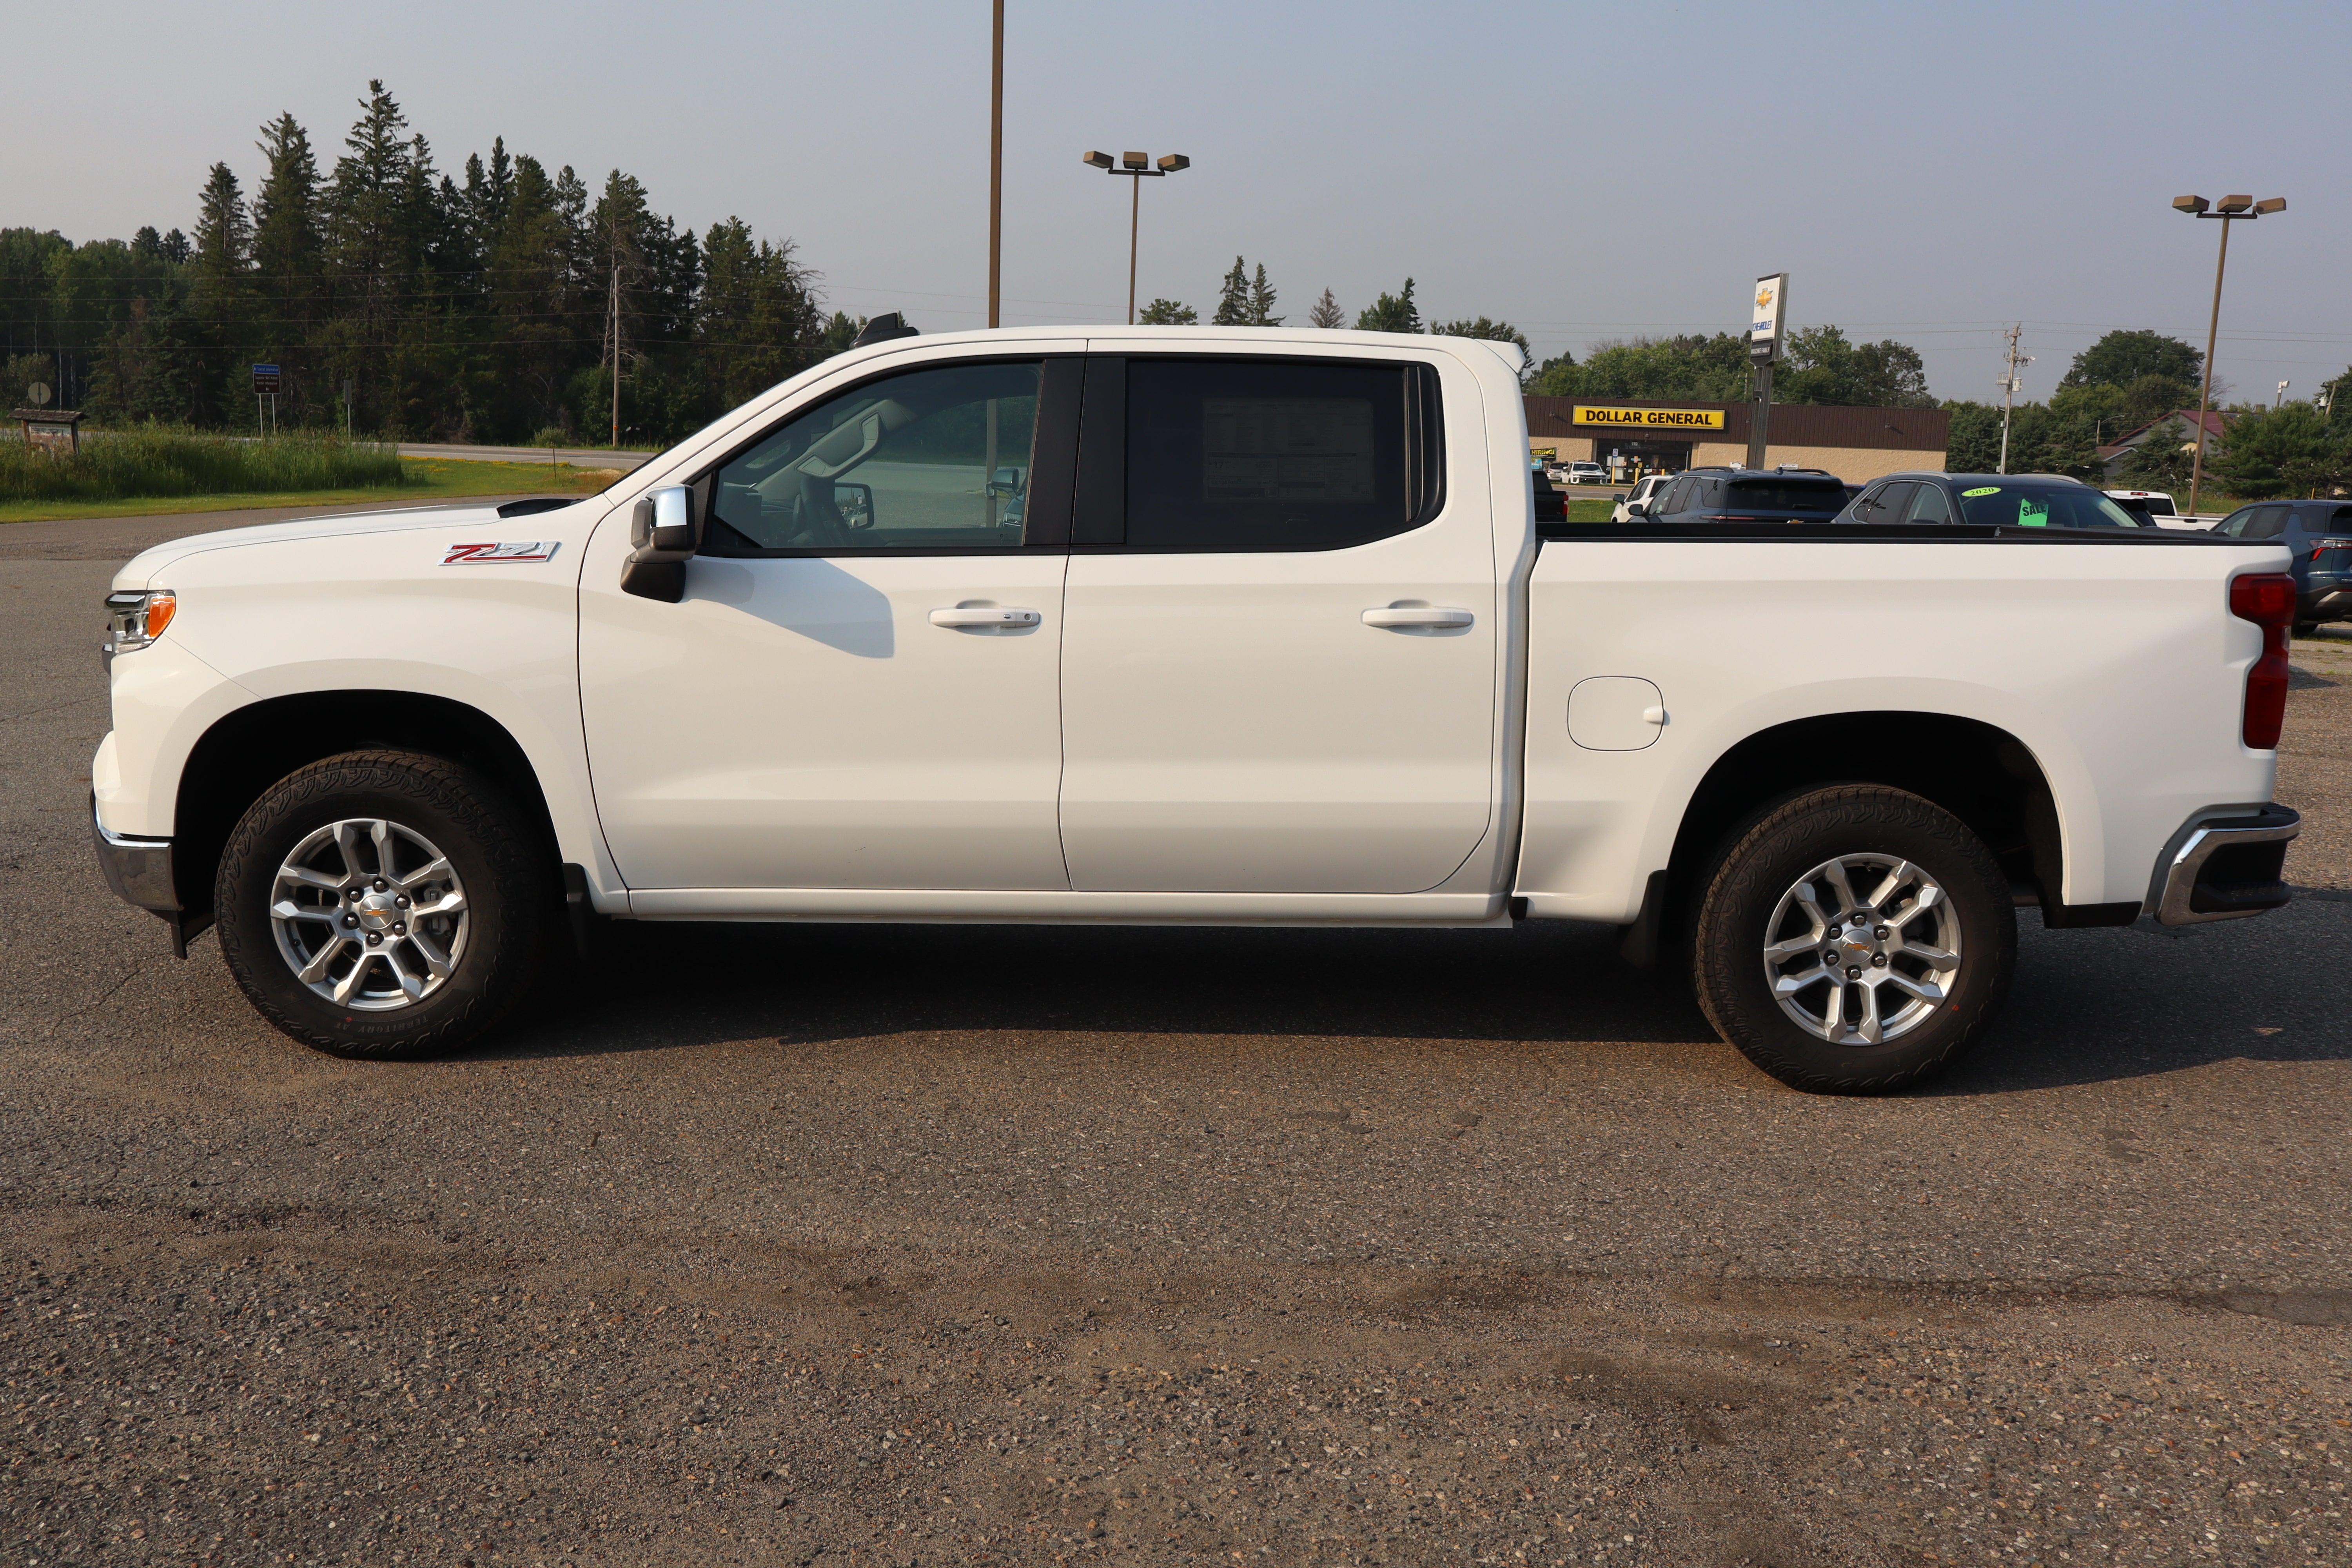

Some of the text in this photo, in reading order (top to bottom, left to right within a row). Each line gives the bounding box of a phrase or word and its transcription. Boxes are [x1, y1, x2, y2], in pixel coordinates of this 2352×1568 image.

[1752, 320, 1772, 332] CHEVROLET
[1586, 410, 1712, 425] DOLLAR GENERAL
[2022, 504, 2046, 516] SALE
[437, 541, 562, 566] Z71
